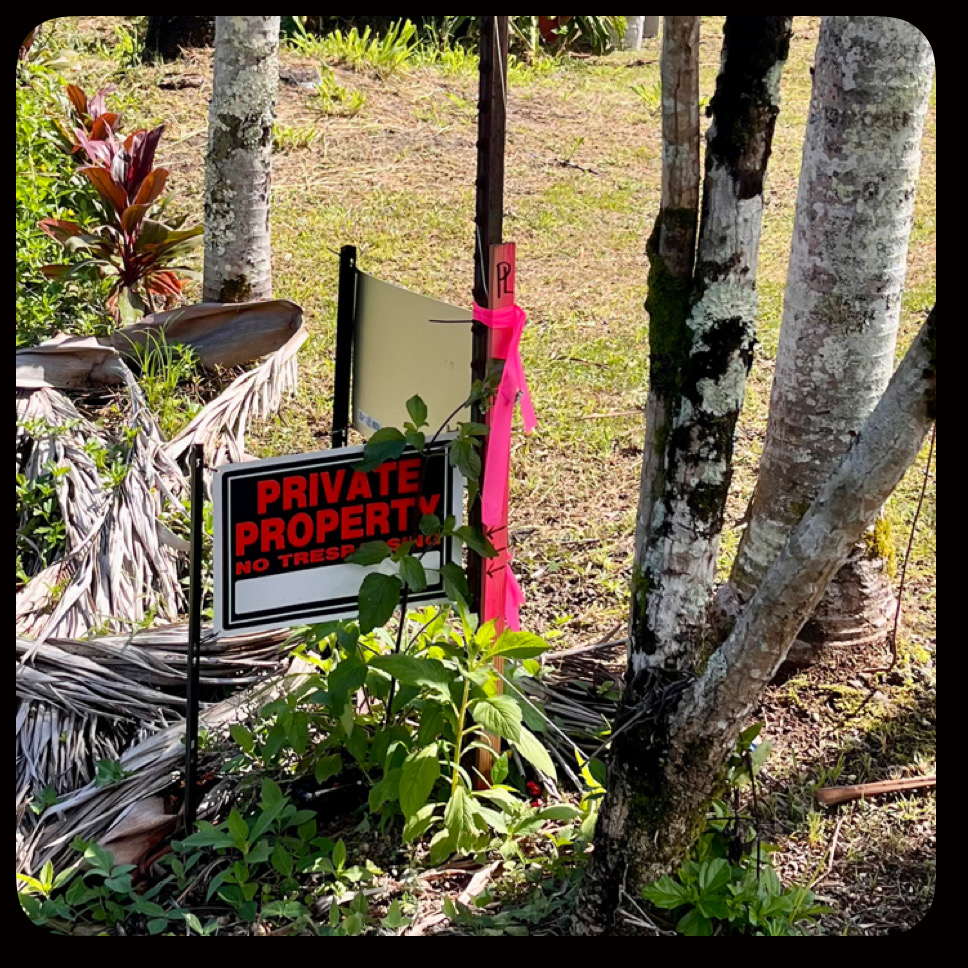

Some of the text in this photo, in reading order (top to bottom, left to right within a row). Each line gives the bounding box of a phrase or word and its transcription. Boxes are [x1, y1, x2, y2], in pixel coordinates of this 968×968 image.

[496, 261, 514, 299] PL
[257, 458, 421, 515] PRIVATE
[235, 494, 441, 557] PROPERTY
[235, 557, 269, 575] NO
